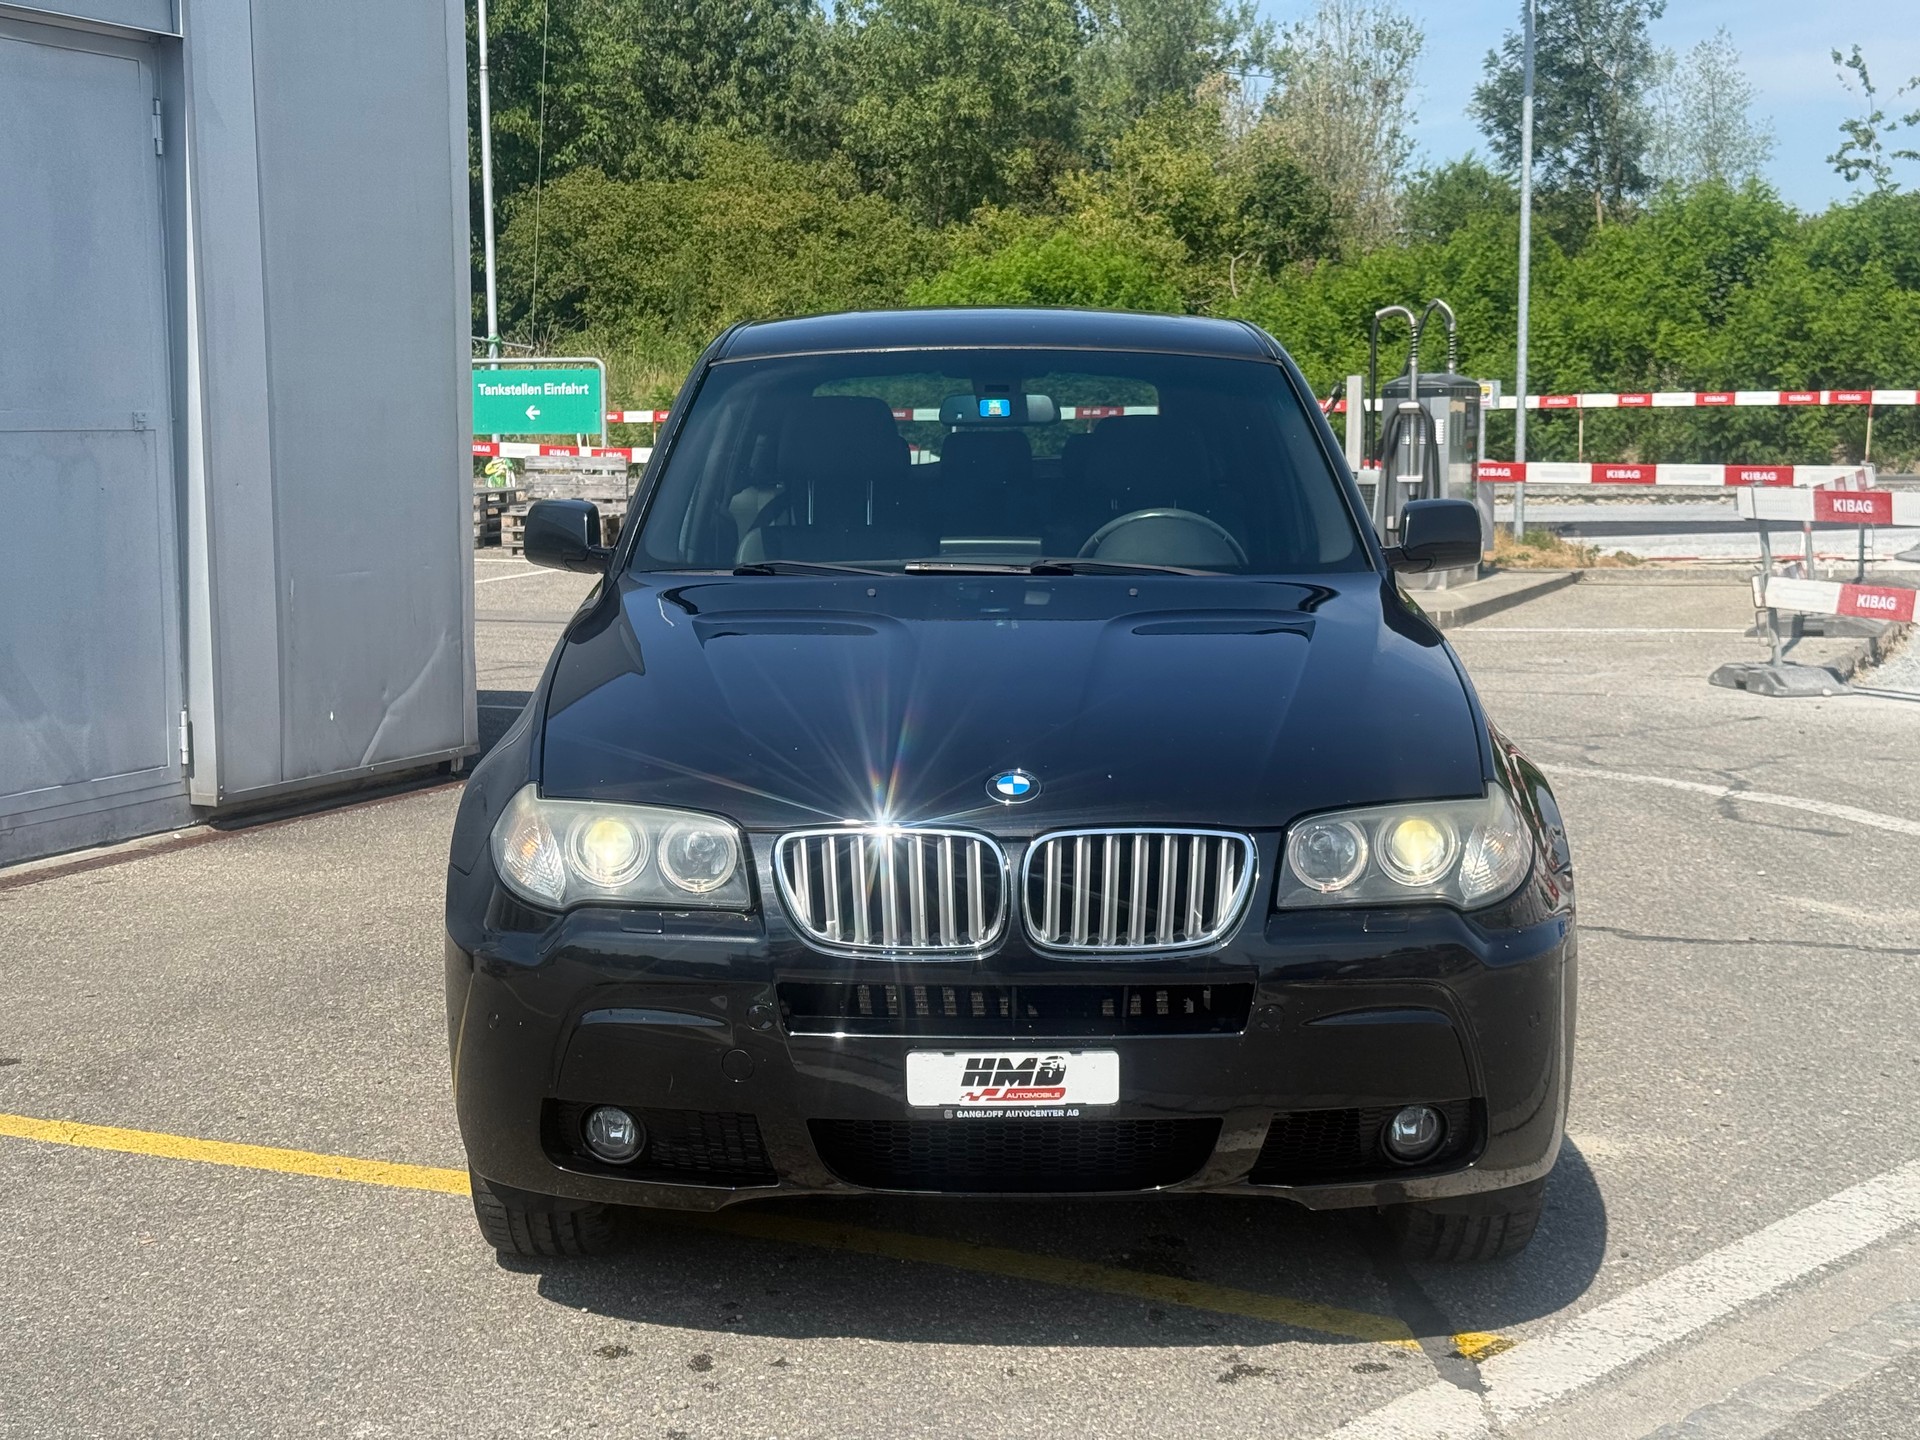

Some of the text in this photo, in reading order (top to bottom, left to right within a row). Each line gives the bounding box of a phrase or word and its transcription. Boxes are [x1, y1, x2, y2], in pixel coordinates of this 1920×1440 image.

[478, 382, 589, 396] Tankstellen Einfahrt
[1478, 468, 1511, 477] KIBAG
[1606, 469, 1641, 480] KIBAG
[1741, 471, 1777, 481] KIBAG
[1833, 498, 1873, 514] KIBAG
[1856, 593, 1896, 611] KIBAG
[1006, 1091, 1061, 1099] AUTOMOBILE
[956, 1110, 1004, 1118] GANGLOFF
[1005, 1109, 1065, 1118] AUTOCENTER
[1067, 1108, 1080, 1117] AG
